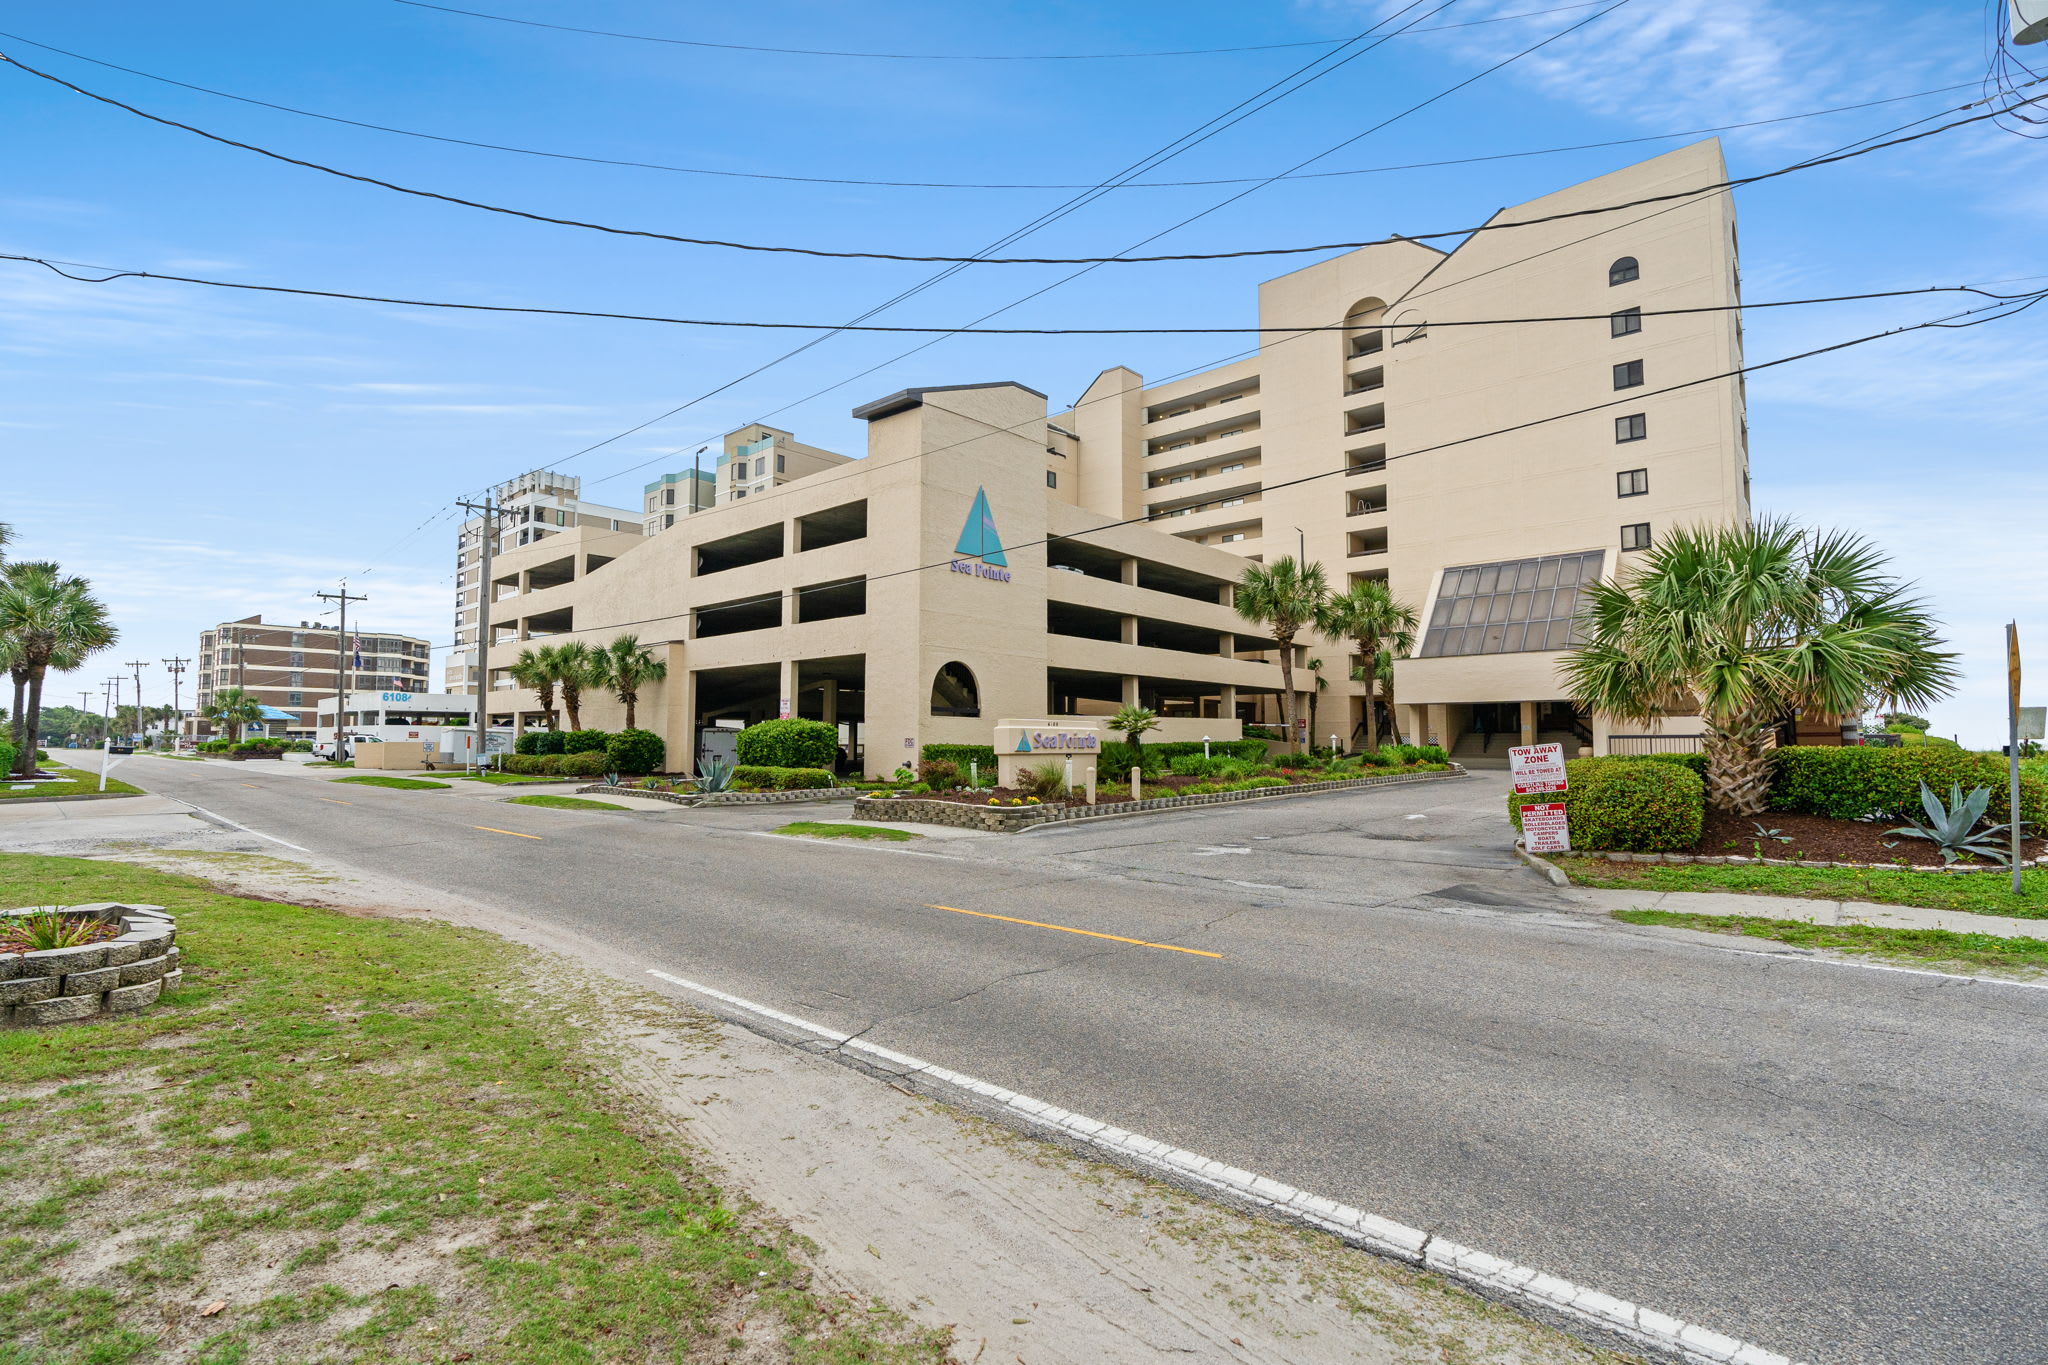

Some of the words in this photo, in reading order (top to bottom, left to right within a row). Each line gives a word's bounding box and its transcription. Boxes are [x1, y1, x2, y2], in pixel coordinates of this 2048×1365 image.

[951, 558, 972, 575] Sea
[975, 563, 1011, 582] Pointe
[383, 692, 408, 702] 6108
[1033, 731, 1057, 749] Sea
[1058, 732, 1096, 749] Pointe
[1512, 749, 1531, 757] TOW
[1533, 746, 1558, 755] AWAY
[1524, 755, 1549, 764] ZONE
